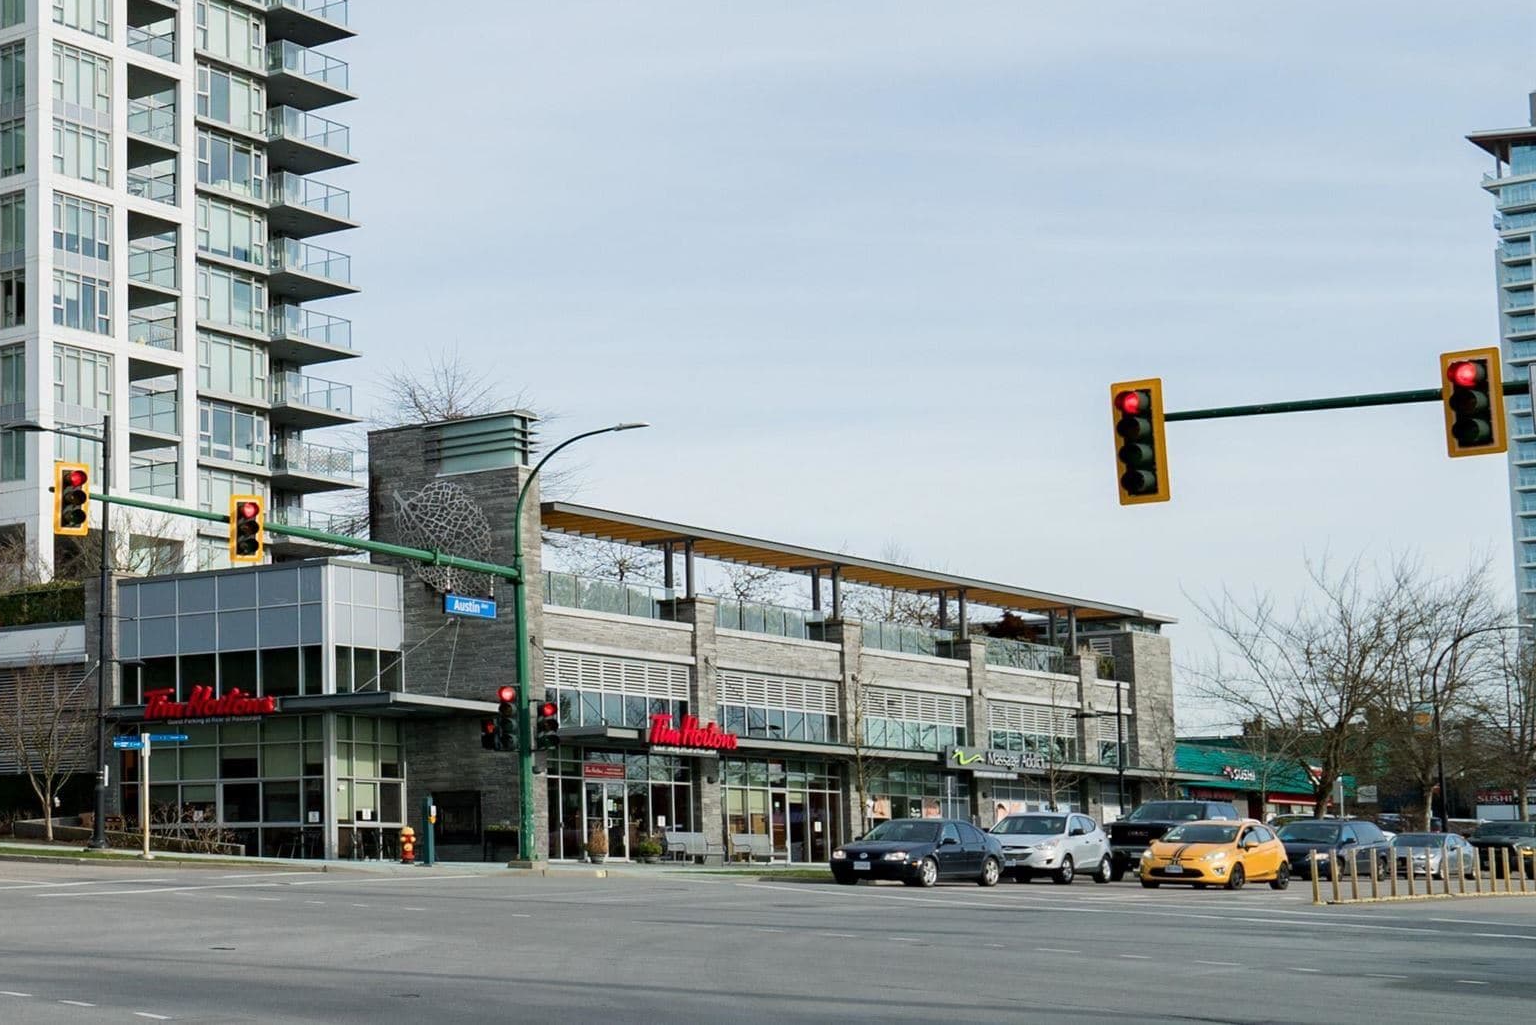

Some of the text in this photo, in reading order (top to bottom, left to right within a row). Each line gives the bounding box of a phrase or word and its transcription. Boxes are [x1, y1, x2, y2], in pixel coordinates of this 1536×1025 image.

[454, 599, 481, 614] Austin
[144, 685, 274, 719] Tim Hortons
[650, 714, 738, 750] Tim Hortons
[987, 752, 1044, 770] Massage Addict
[1233, 768, 1256, 781] SUSHI
[1476, 794, 1513, 803] SUSHI
